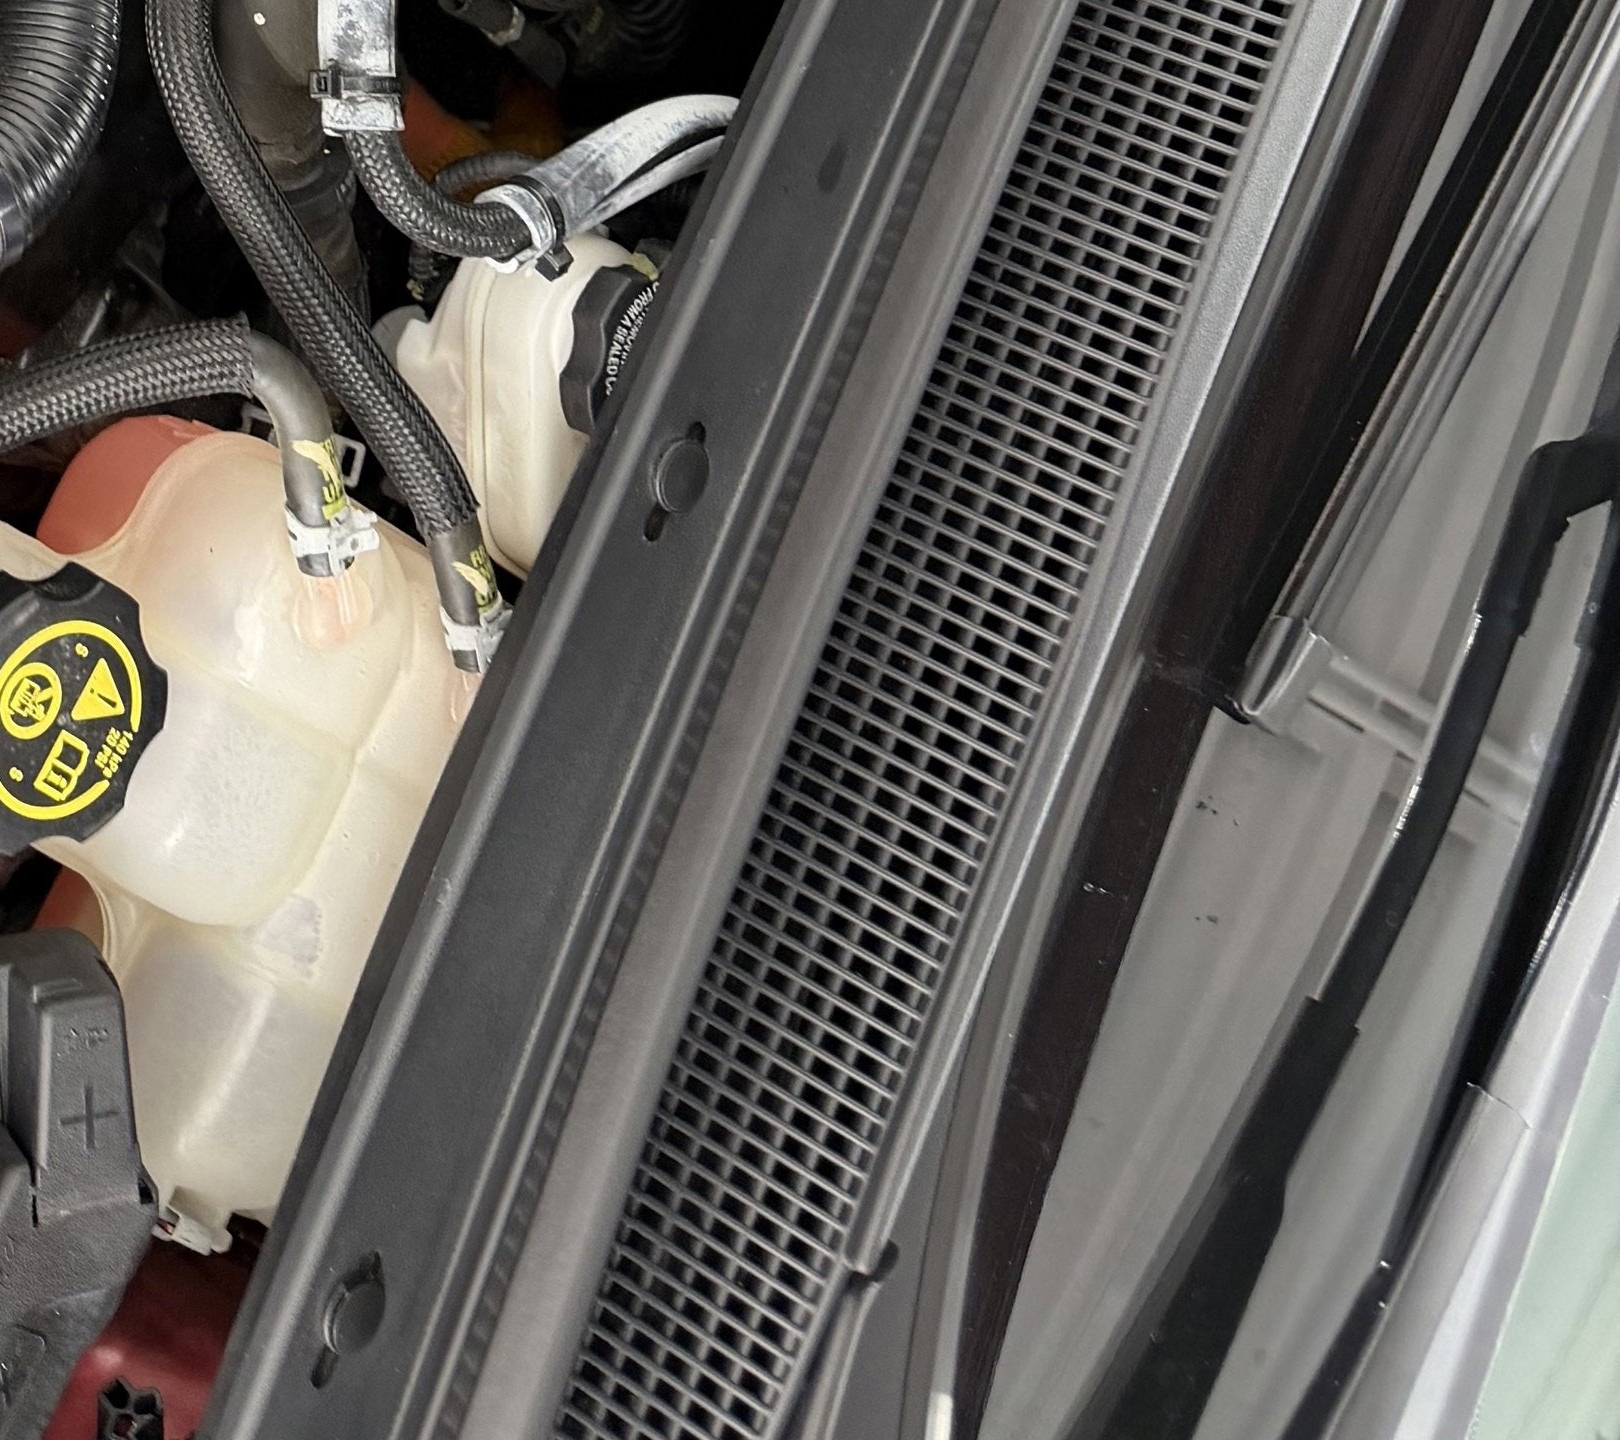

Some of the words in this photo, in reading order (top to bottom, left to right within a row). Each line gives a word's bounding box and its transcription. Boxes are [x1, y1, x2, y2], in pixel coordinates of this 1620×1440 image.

[627, 287, 654, 320] FROM
[606, 325, 629, 376] SEALED
[106, 727, 121, 747] 20
[116, 730, 133, 756] 140
